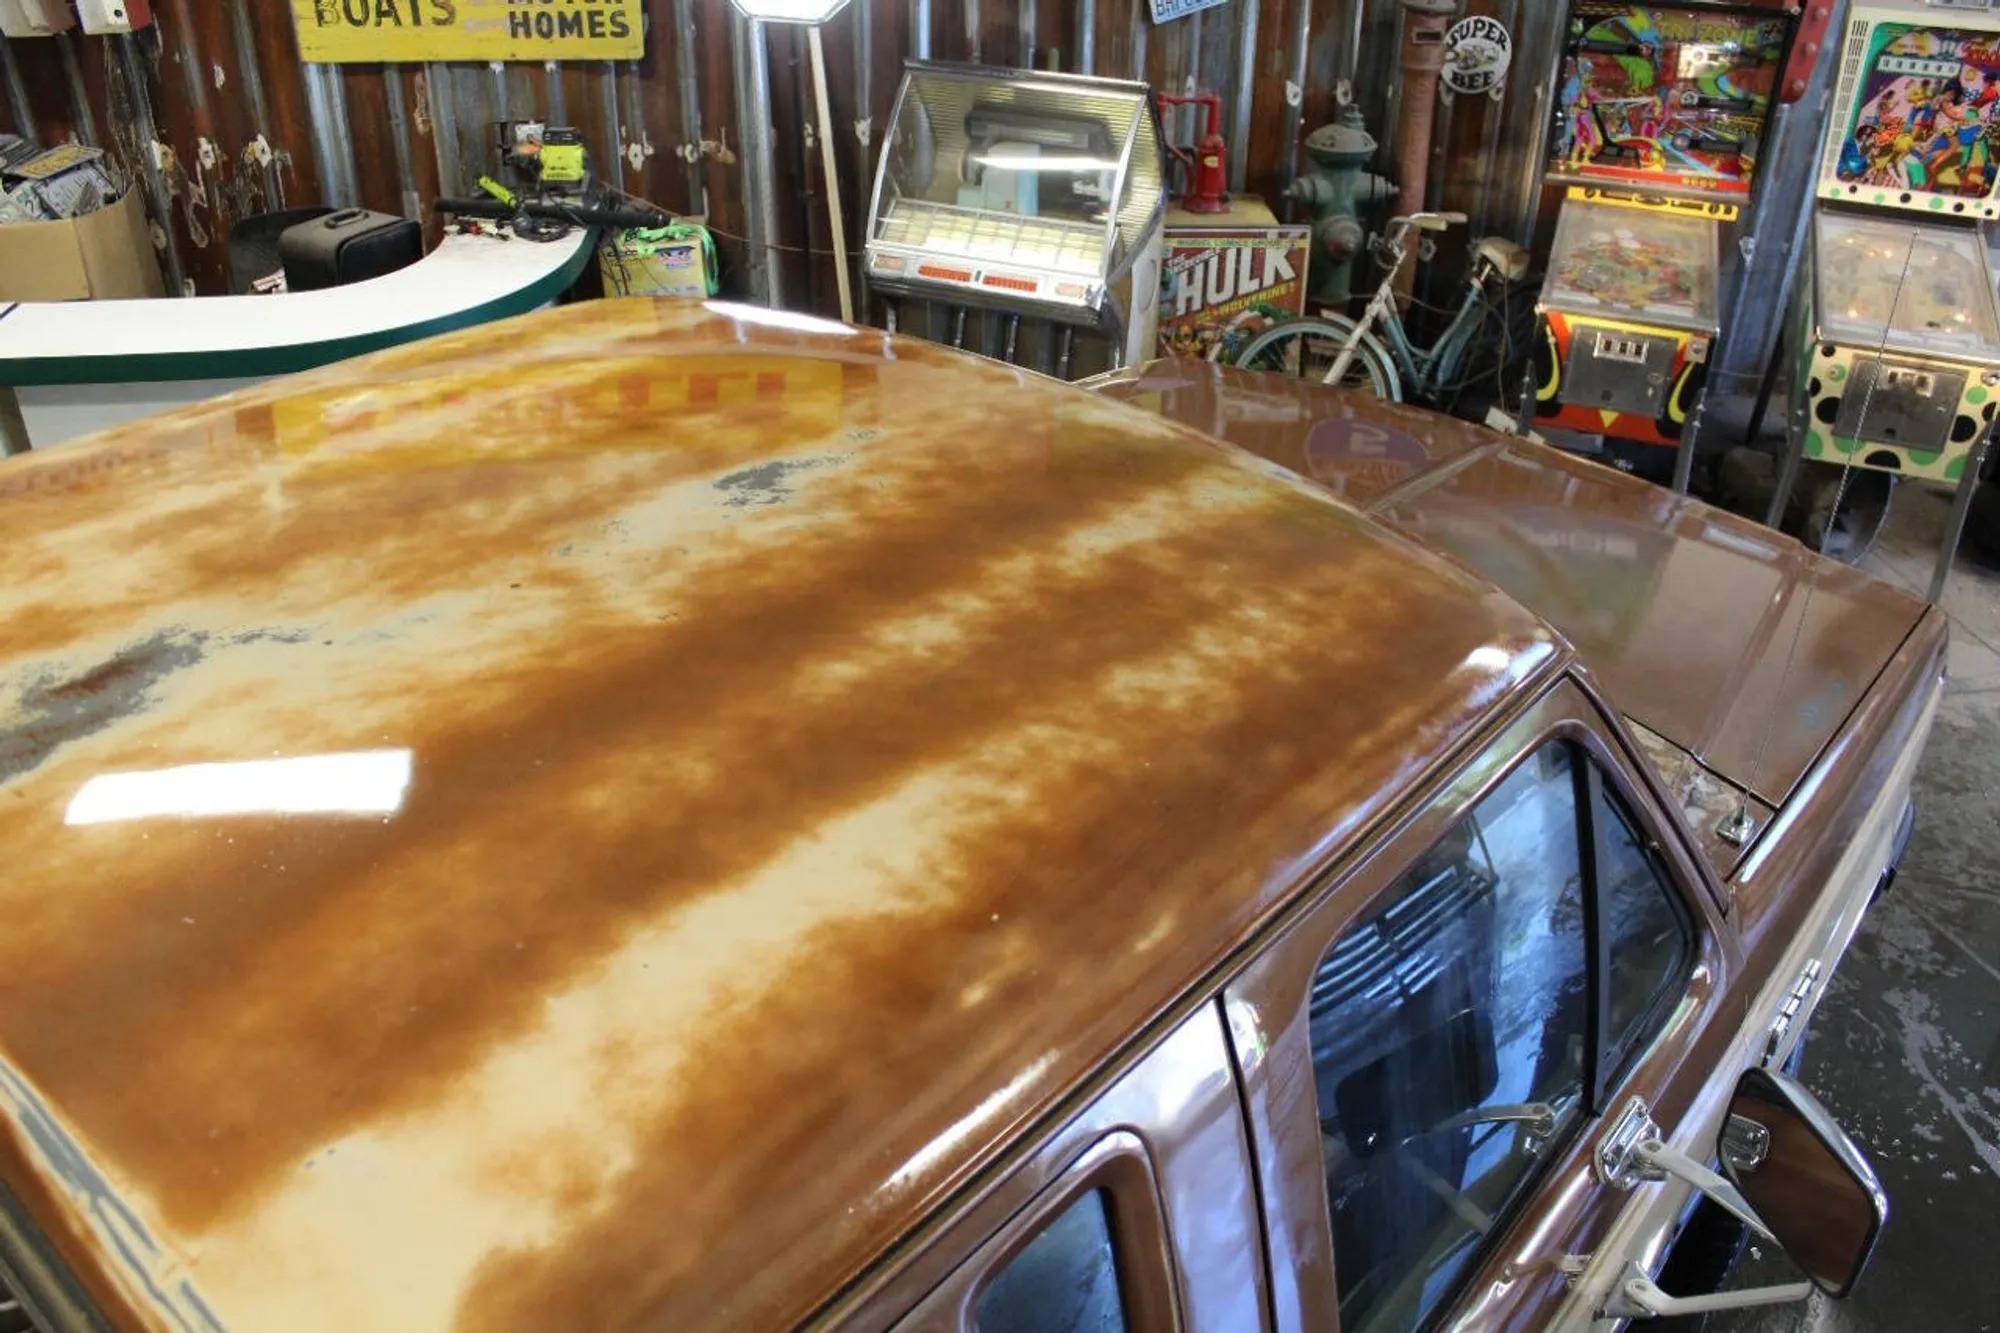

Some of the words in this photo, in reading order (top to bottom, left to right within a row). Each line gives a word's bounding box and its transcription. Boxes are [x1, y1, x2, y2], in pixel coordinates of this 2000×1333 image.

[315, 0, 457, 28] BOATS
[508, 10, 631, 39] HOMES
[1446, 18, 1508, 52] SUPER
[1451, 70, 1495, 90] BEE
[1176, 229, 1296, 317] HULK
